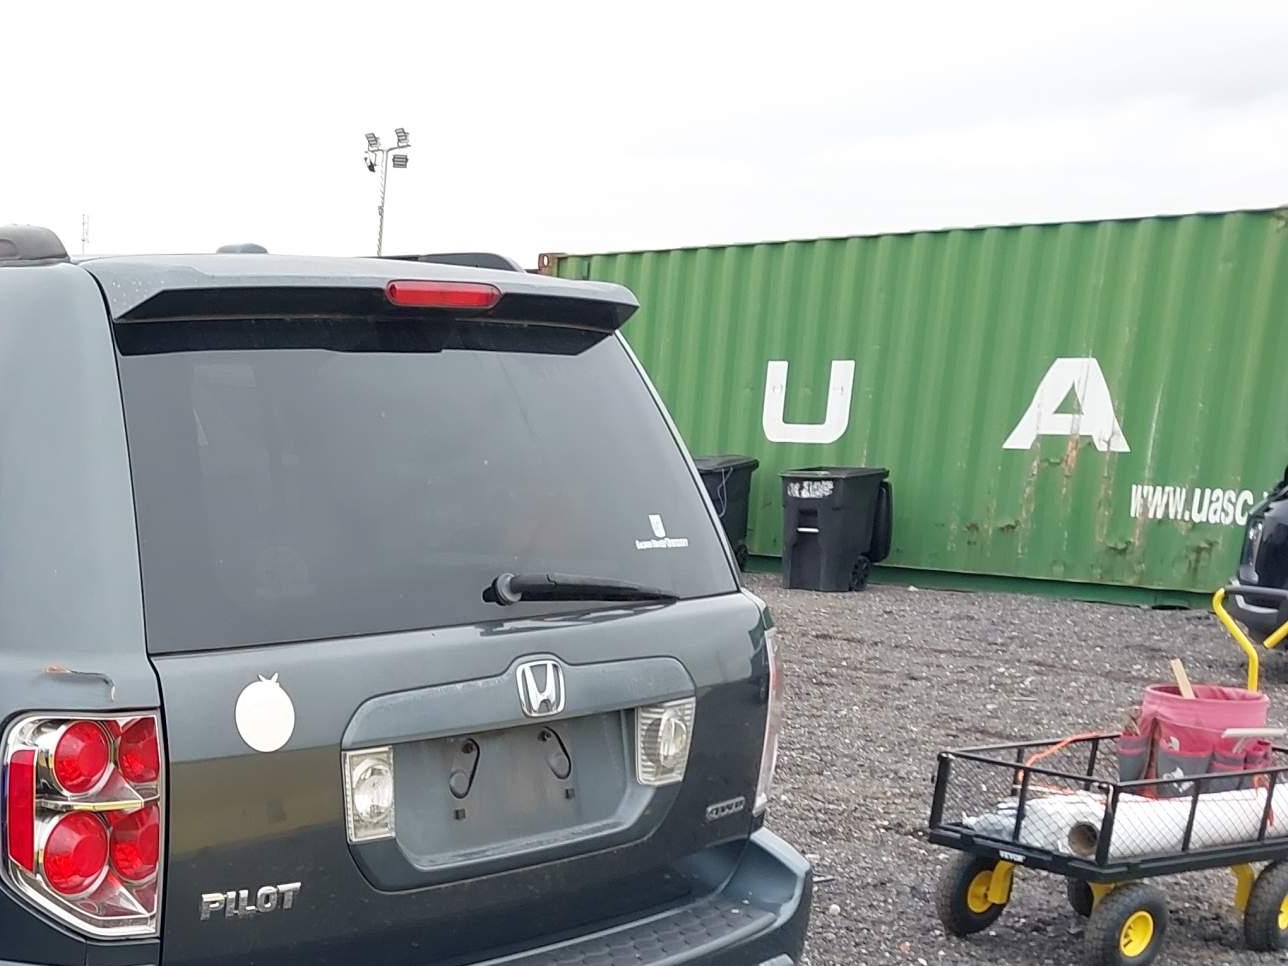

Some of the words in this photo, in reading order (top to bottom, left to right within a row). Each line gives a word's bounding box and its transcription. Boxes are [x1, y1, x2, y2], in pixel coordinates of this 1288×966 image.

[762, 359, 856, 444] U
[1001, 357, 1132, 453] A
[1130, 484, 1268, 526] www.uasc
[200, 881, 302, 921] PILOT
